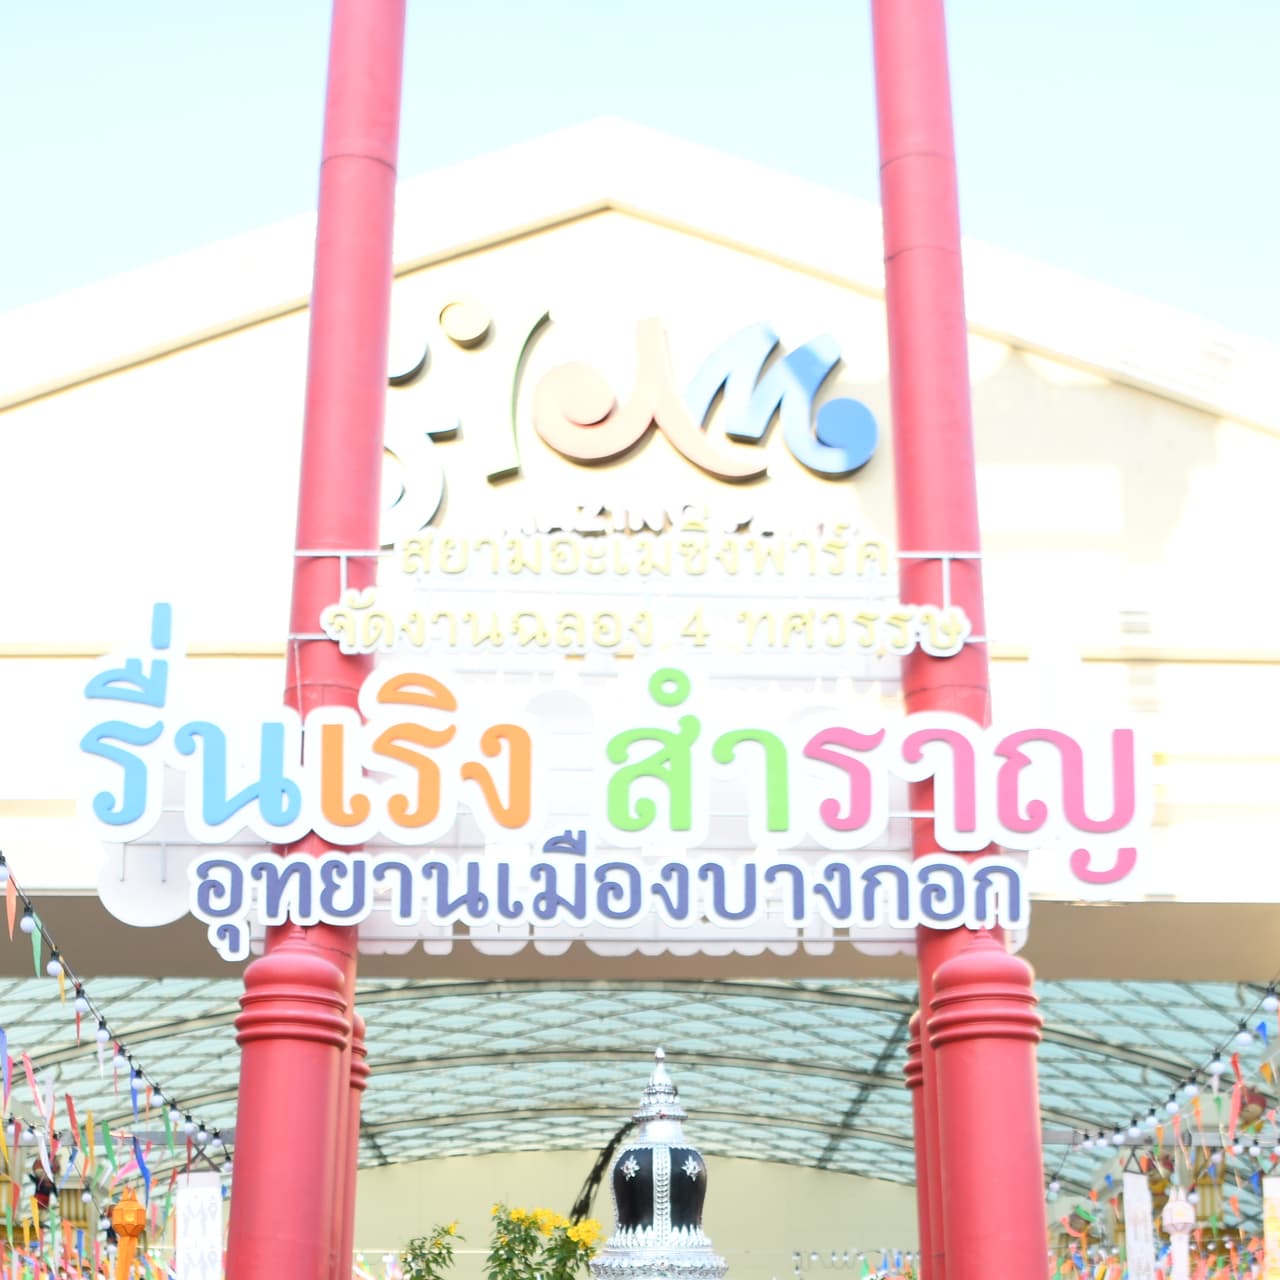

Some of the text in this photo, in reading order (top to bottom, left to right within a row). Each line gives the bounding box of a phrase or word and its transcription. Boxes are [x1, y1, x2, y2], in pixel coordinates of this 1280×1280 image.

[326, 588, 963, 650] จัดงานฉลอง 4 ทศวรรษ
[79, 601, 1138, 885] รื่นเริง สำราญ
[195, 829, 1021, 954] อุทยานเมืองบางกอก
